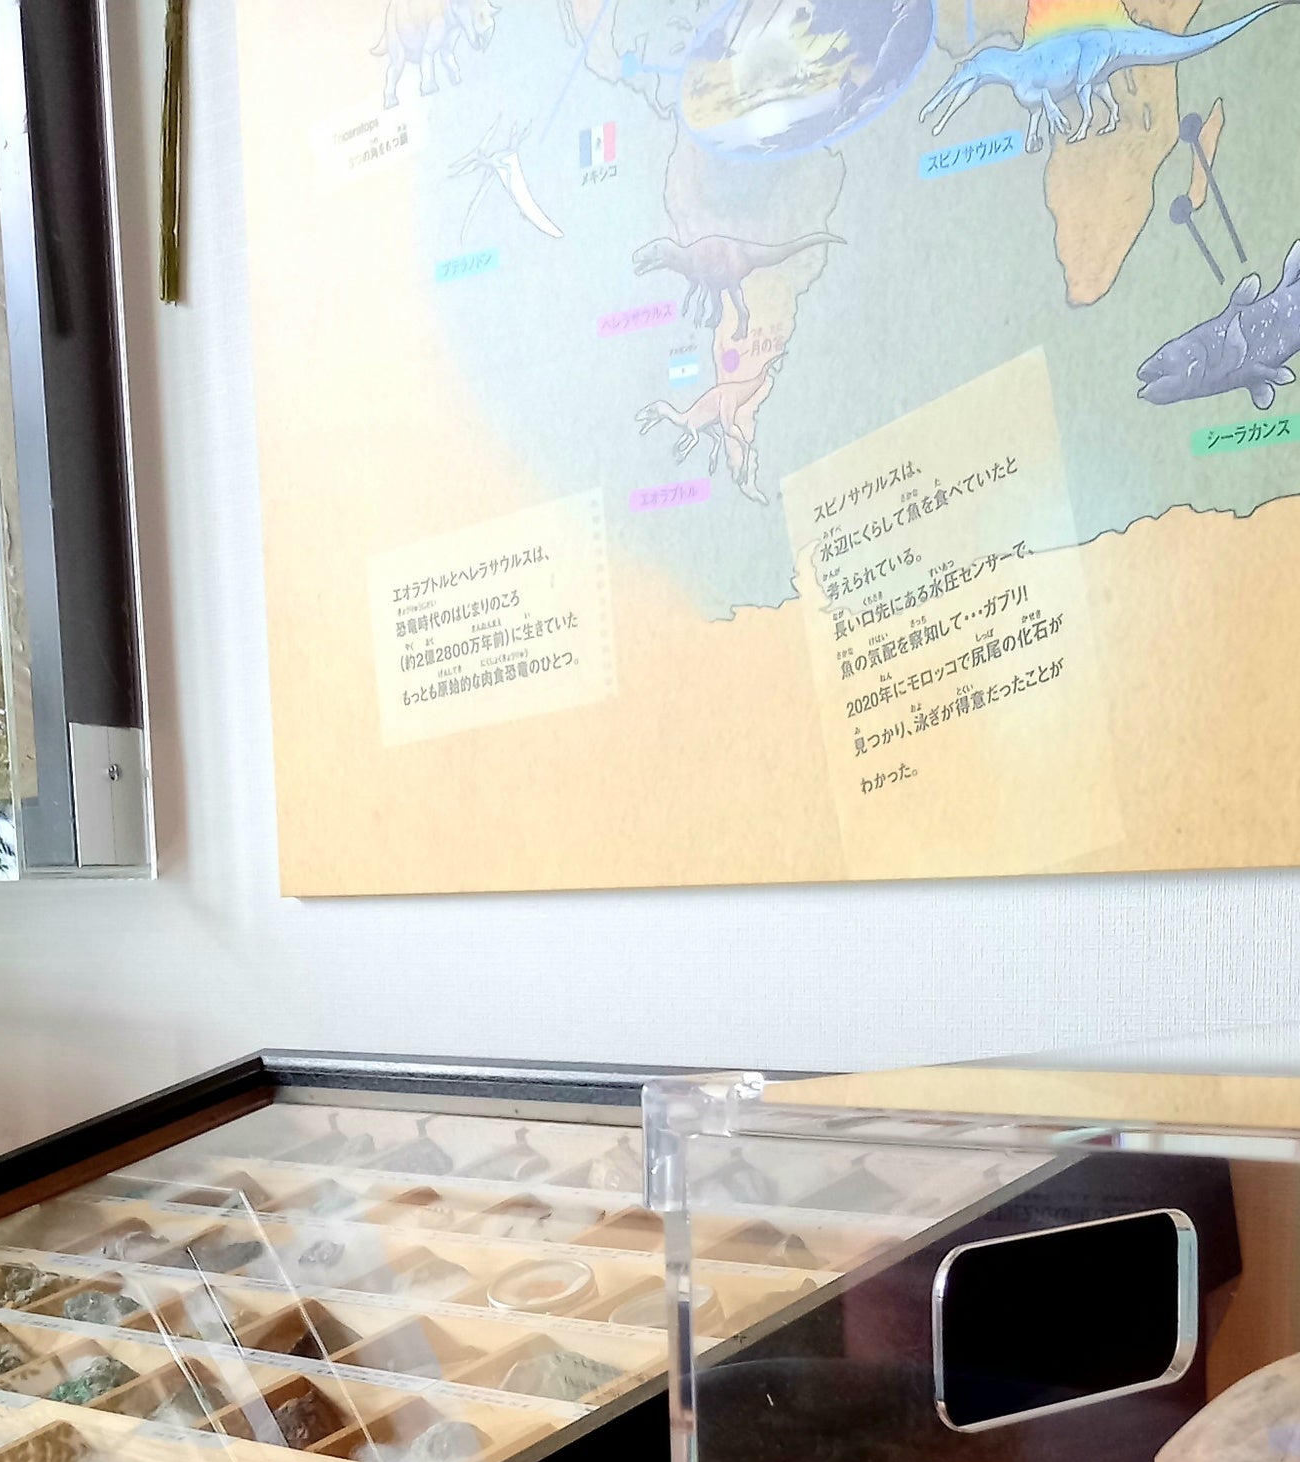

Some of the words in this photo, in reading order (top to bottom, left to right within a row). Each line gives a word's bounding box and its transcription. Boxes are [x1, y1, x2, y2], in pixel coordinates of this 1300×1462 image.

[928, 135, 1014, 172] スピノサウルス
[1207, 419, 1290, 449] シーラカンス
[813, 460, 922, 523] スピノサウルスは、
[820, 456, 1018, 562] 水辺にくらして魚を食べていたと
[392, 546, 550, 603] エオラプトルとヘレラサウルスは、
[827, 548, 922, 601] 考えられている。
[834, 540, 1034, 641] 長い口先にある水圧センサーで、
[395, 589, 520, 637] 恐竜時代のはじまりのころ
[402, 651, 580, 707] もっとも原始的な肉食恐竜のひとつ。
[847, 613, 1063, 718] 2020年にモロッコで尻尾の化石が
[854, 657, 1064, 757] 見つかり、泳ぎが得意だったことが
[860, 763, 918, 795] わかった。
